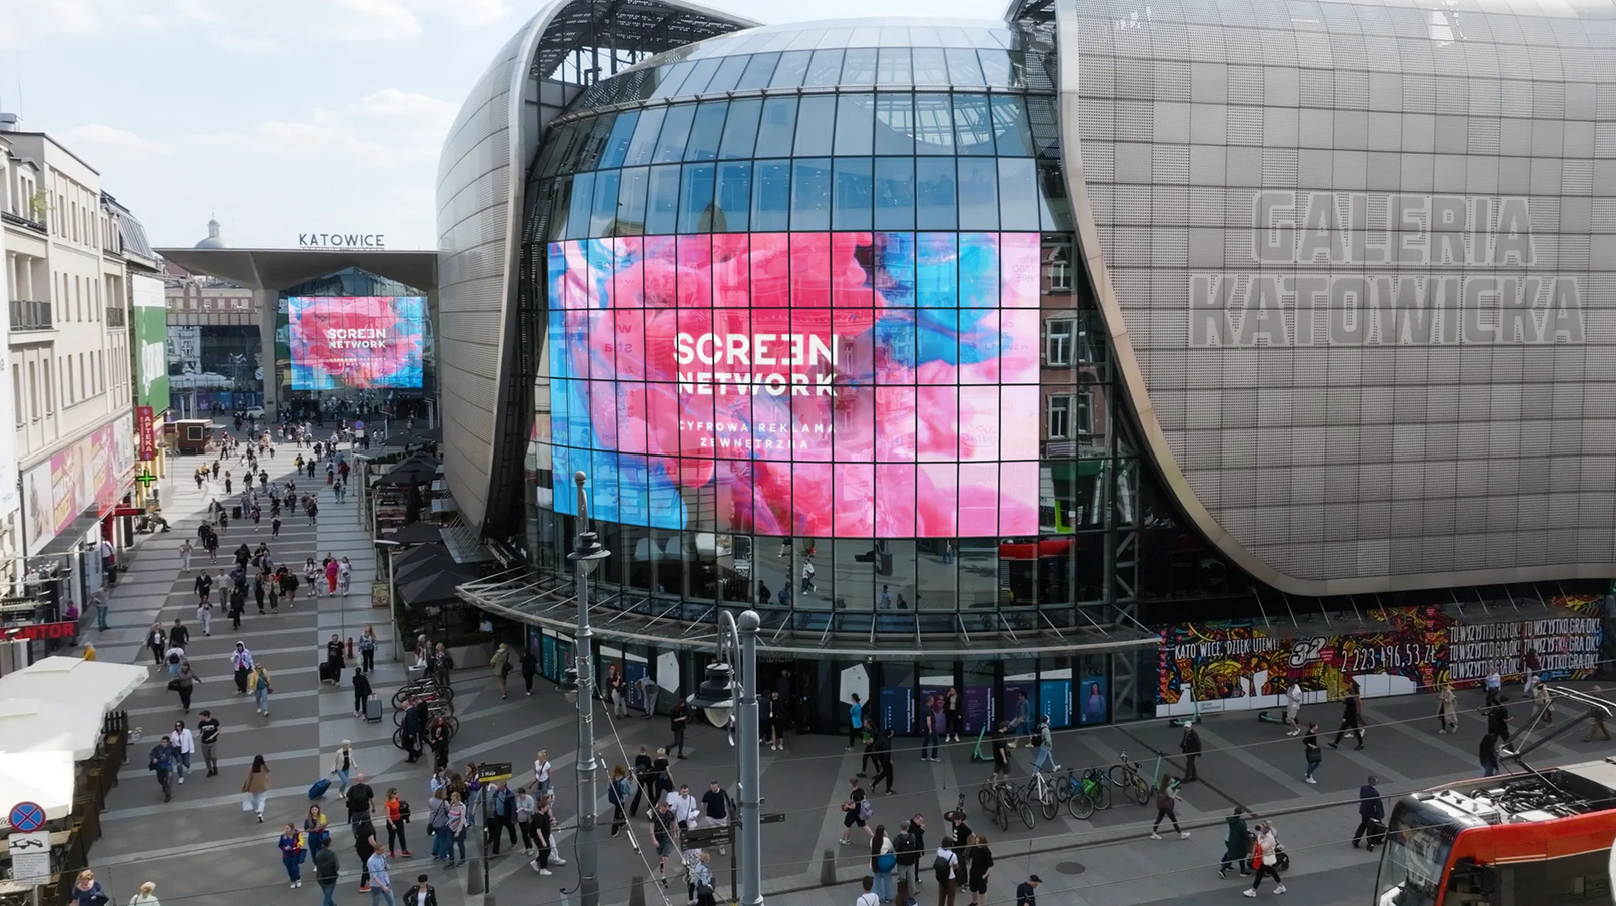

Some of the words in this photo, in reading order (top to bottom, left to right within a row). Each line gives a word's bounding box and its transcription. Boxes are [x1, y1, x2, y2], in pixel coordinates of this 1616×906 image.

[1252, 191, 1536, 265] GALERIA
[299, 233, 385, 246] KATOWICE
[1188, 275, 1585, 346] KATOWICKA
[329, 340, 386, 349] NETWORK
[676, 371, 838, 397] NETWORK
[144, 416, 153, 452] APTEKA
[679, 421, 748, 432] CYFROWA
[758, 423, 837, 433] REKLAMA
[1569, 618, 1585, 634] GRA
[1586, 617, 1600, 633] OK!
[1569, 636, 1584, 652] GRA
[1586, 636, 1599, 651] OK!
[1568, 654, 1584, 670] GRA
[1585, 653, 1599, 669] OK!
